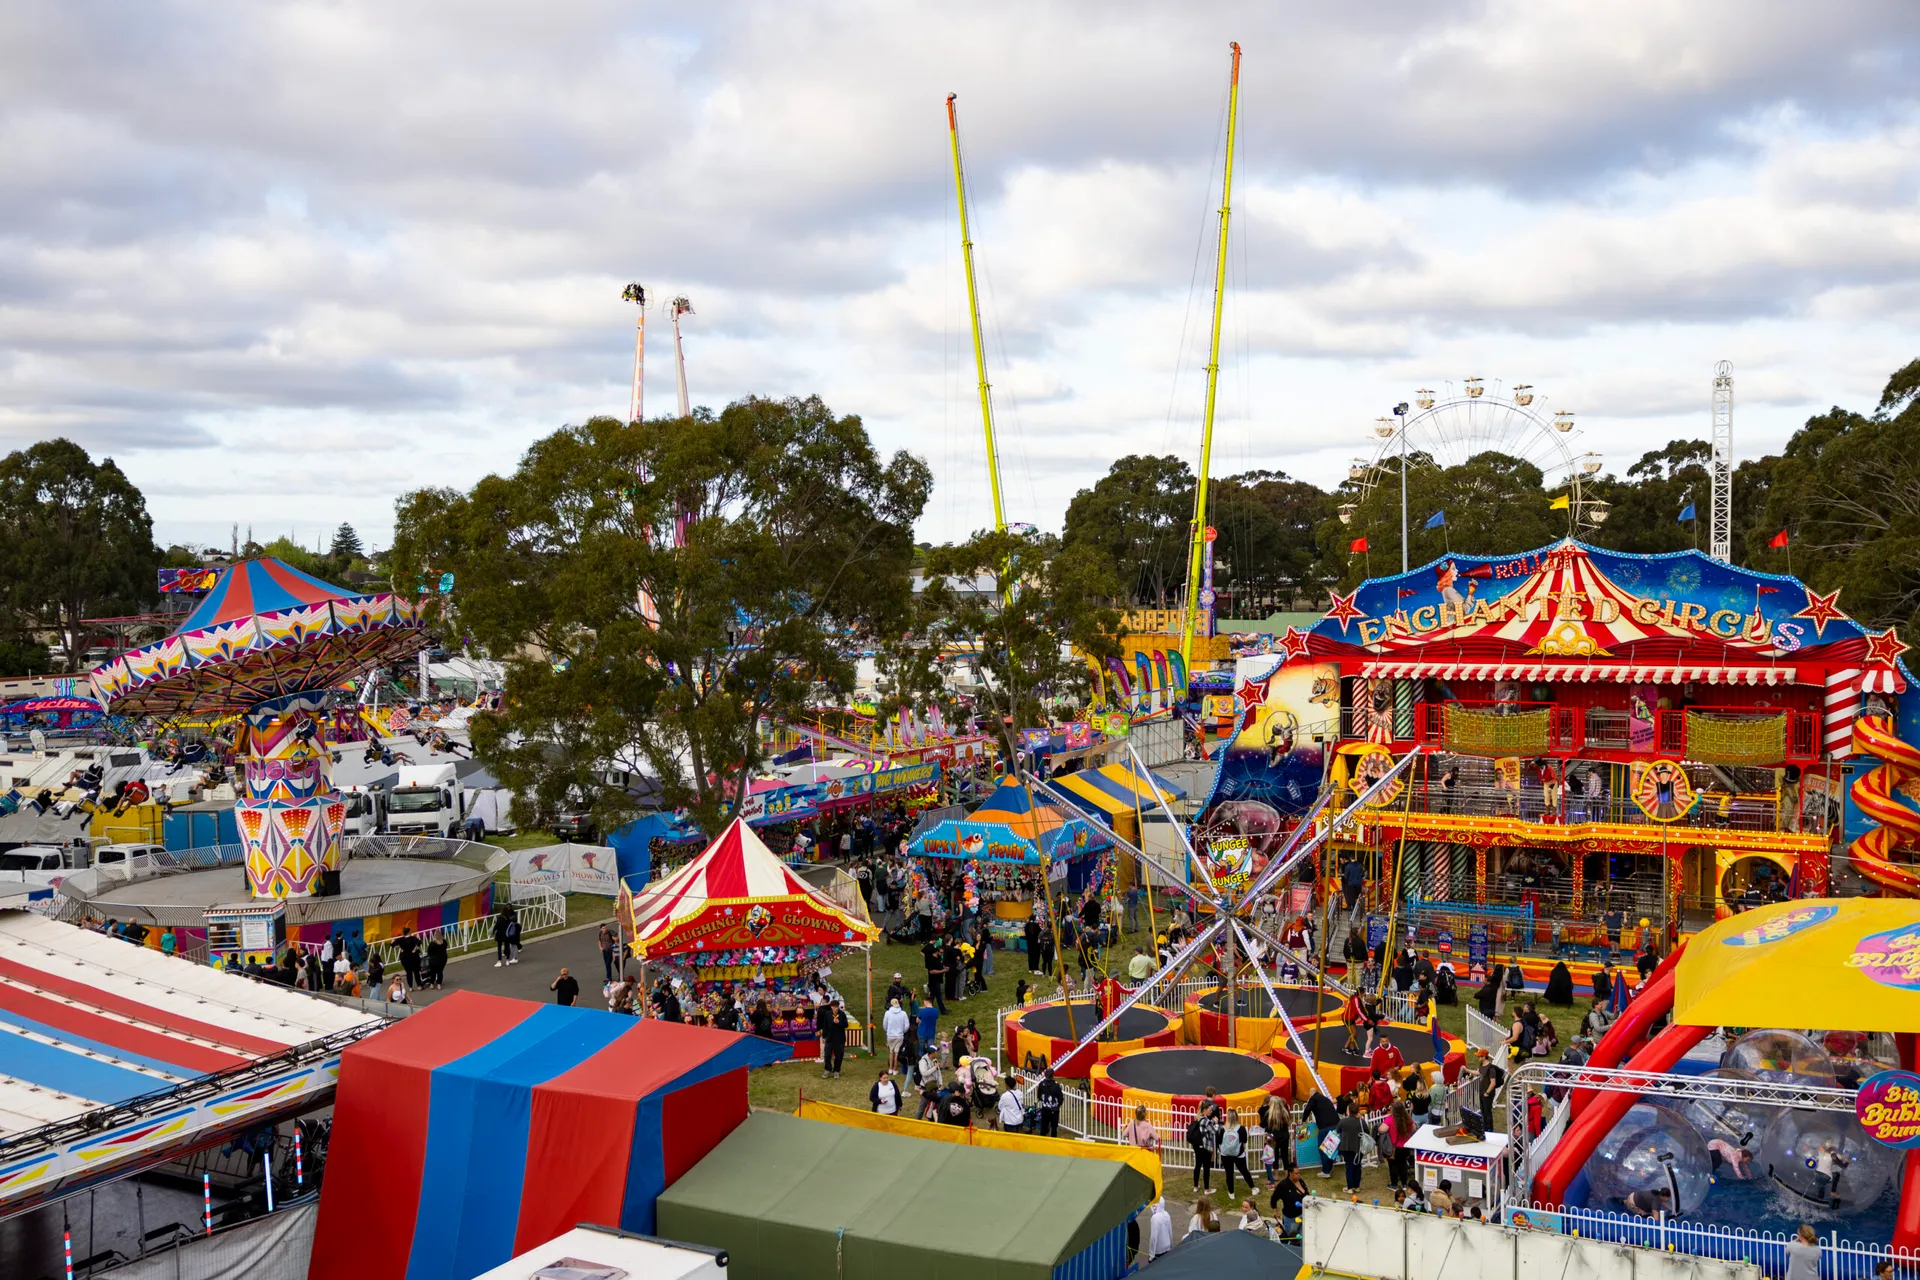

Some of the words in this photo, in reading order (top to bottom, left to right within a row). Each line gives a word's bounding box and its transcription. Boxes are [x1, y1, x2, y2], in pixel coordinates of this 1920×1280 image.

[1496, 554, 1549, 579] ROLL
[1546, 545, 1576, 571] UP
[1357, 595, 1621, 647] ENCHANTED
[1631, 598, 1806, 652] CIRCUS
[875, 773, 892, 788] BIG
[893, 765, 934, 785] WINNERS
[924, 839, 957, 854] LUCKY
[1211, 838, 1248, 852] FUNGEE
[543, 869, 567, 881] WEST
[571, 870, 593, 880] SHOW
[594, 872, 616, 882] WEST
[1211, 871, 1250, 888] BUNGEE
[664, 914, 736, 950] LAUGHING
[782, 913, 841, 933] CLOWNS
[1884, 1086, 1919, 1108] Big
[1420, 1150, 1483, 1168] TICKETS
